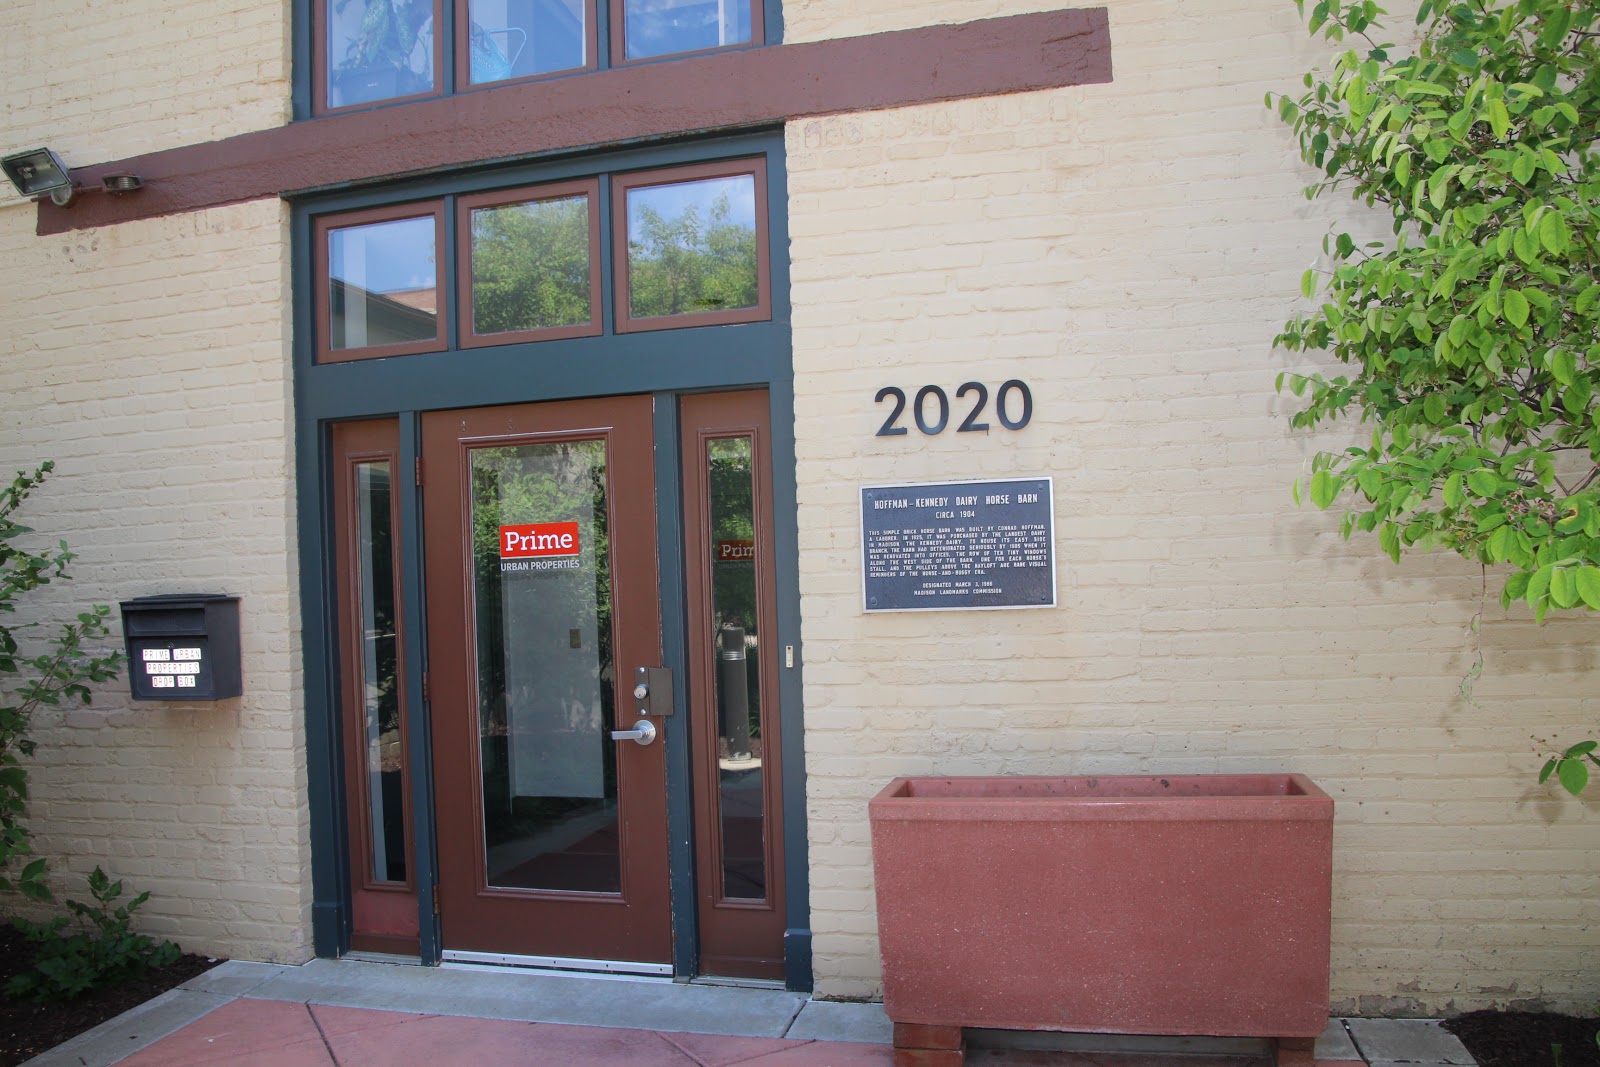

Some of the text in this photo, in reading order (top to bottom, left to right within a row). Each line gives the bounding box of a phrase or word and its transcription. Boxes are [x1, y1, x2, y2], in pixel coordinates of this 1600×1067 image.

[874, 379, 1032, 436] 2020
[956, 496, 977, 506] DAIRY
[986, 494, 1009, 505] HORSE
[1018, 493, 1038, 504] BARN
[504, 530, 573, 552] Prime
[721, 544, 753, 557] Prim
[500, 560, 580, 571] URBAN PROPERTIES
[144, 649, 200, 660] PRIME URBAN
[148, 663, 199, 673] PROPERTIES
[153, 676, 194, 686] DROP BOX
